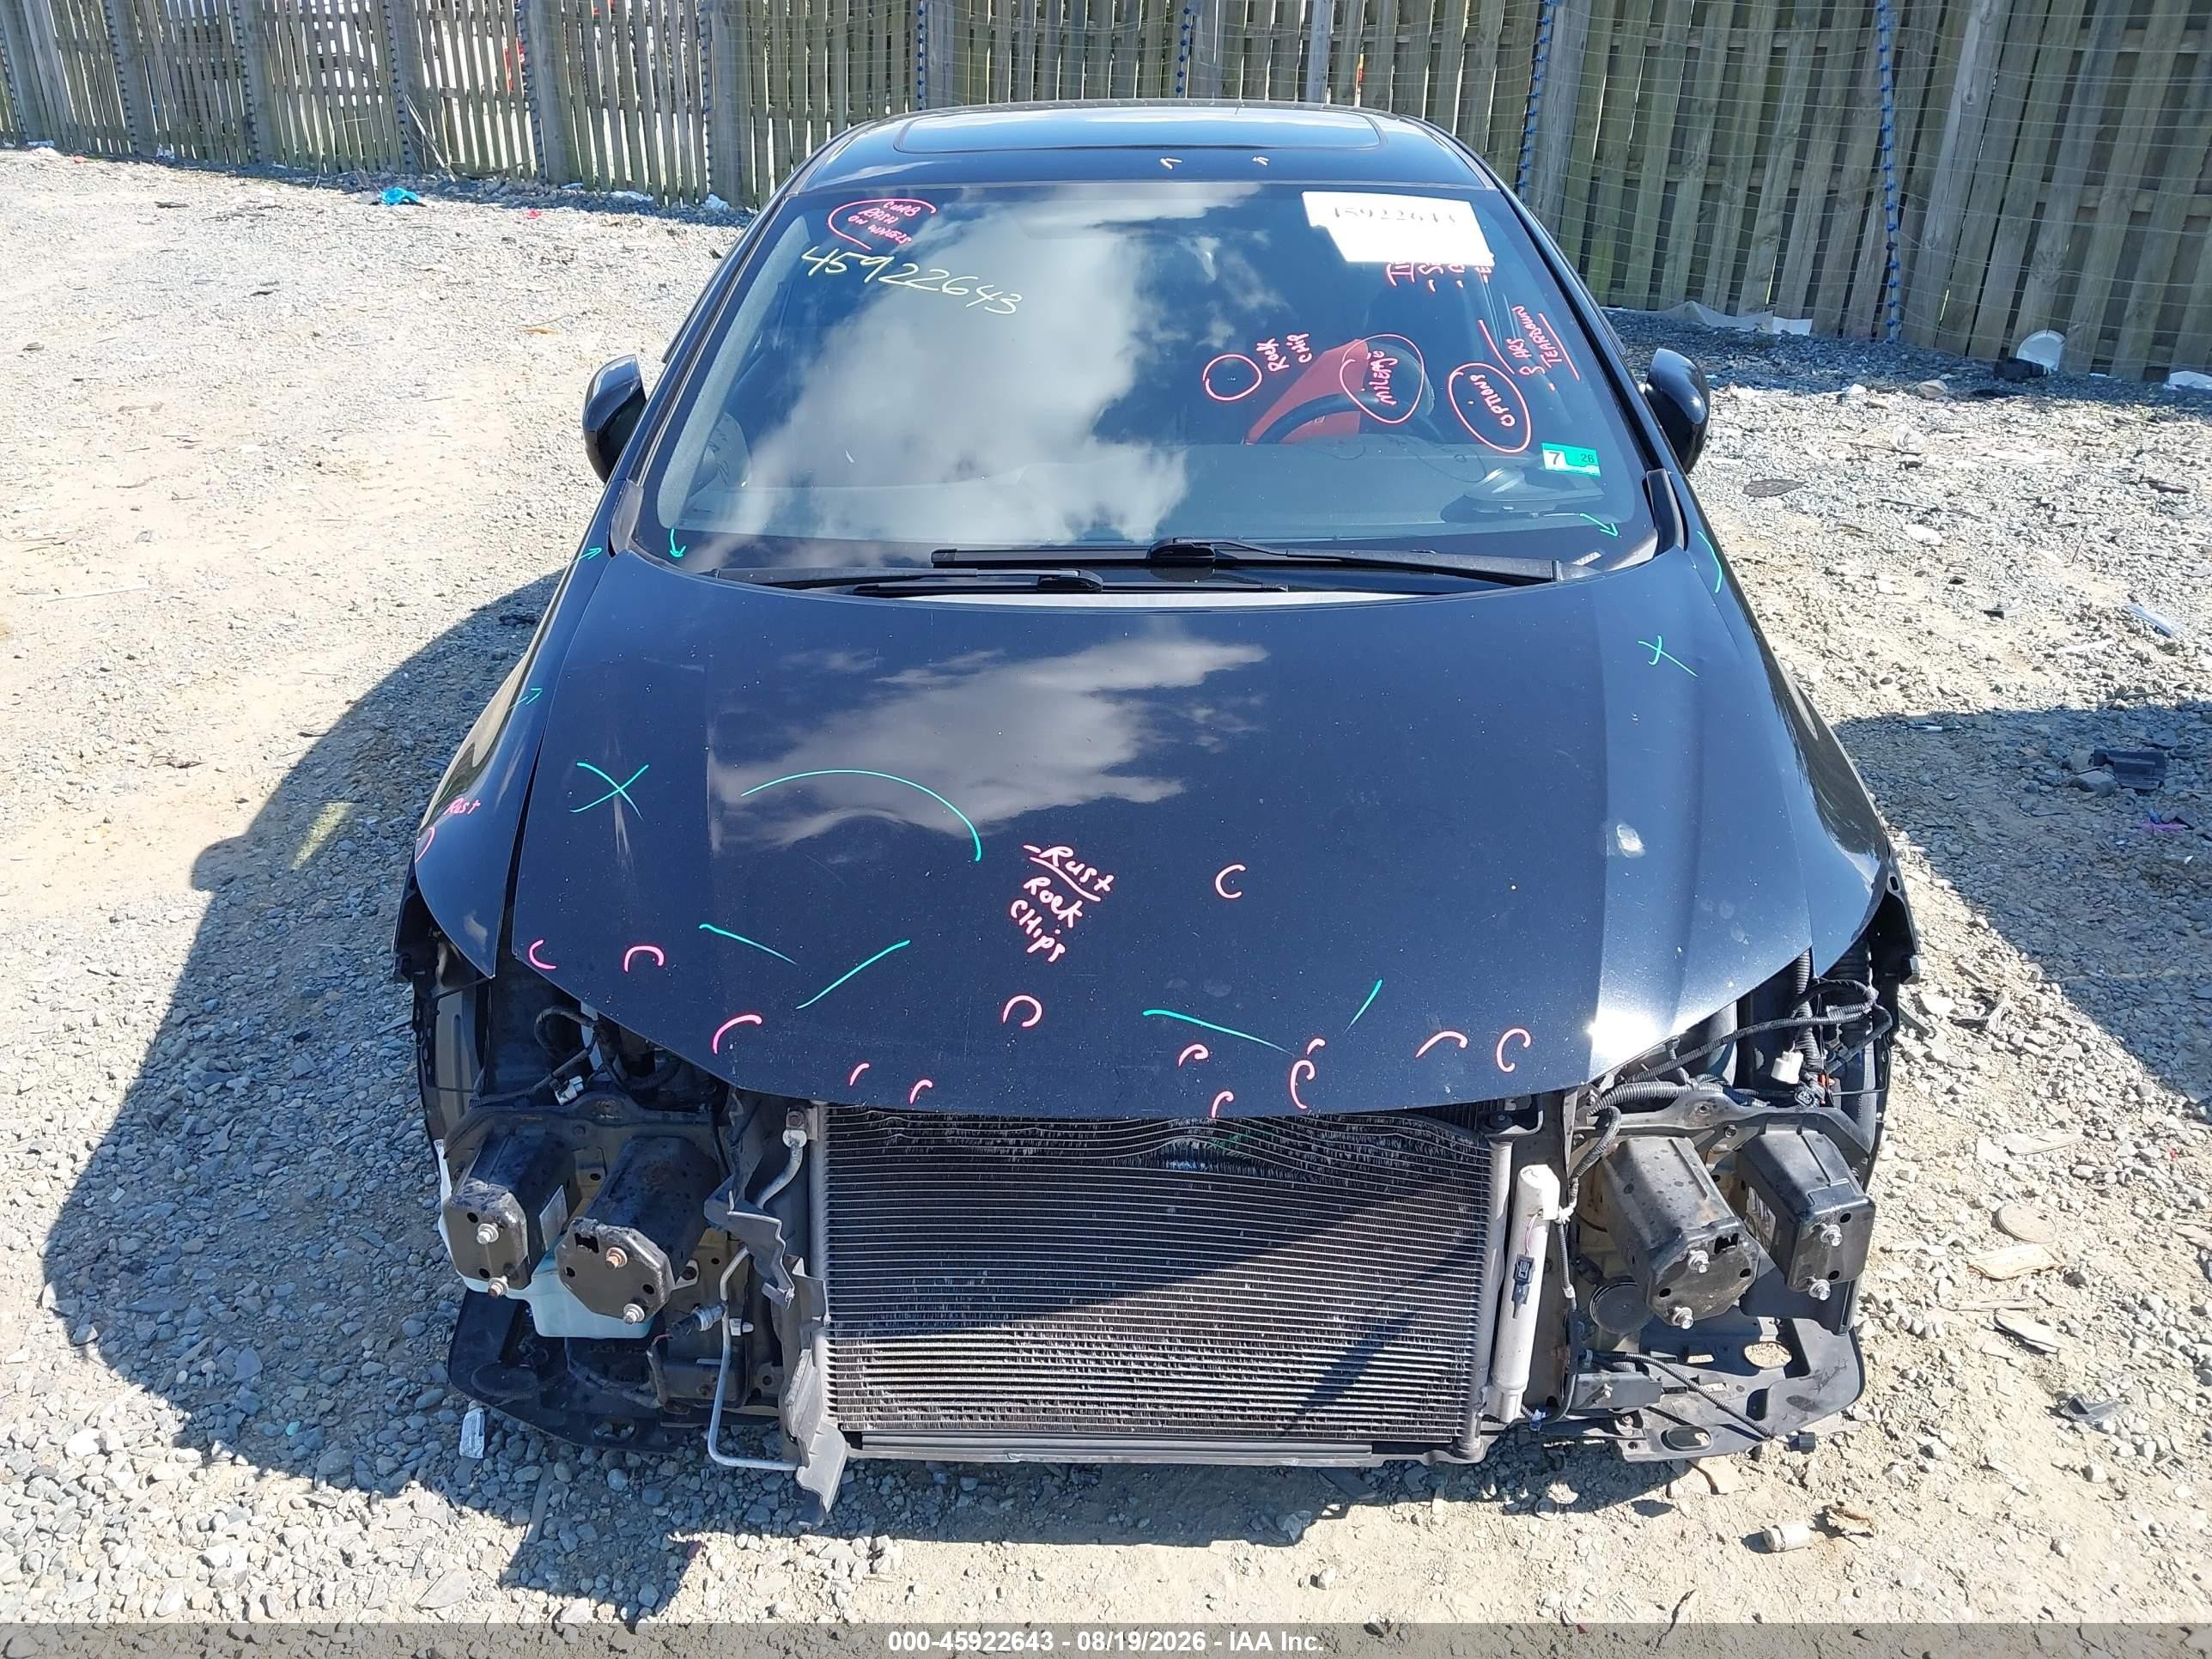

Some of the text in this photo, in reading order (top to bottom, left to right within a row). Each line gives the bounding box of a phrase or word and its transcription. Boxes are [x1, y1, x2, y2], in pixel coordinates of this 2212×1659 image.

[848, 215, 869, 227] ON
[800, 246, 1024, 314] 45922643
[1469, 374, 1516, 428] OPTIONS
[1548, 452, 1561, 465] 7
